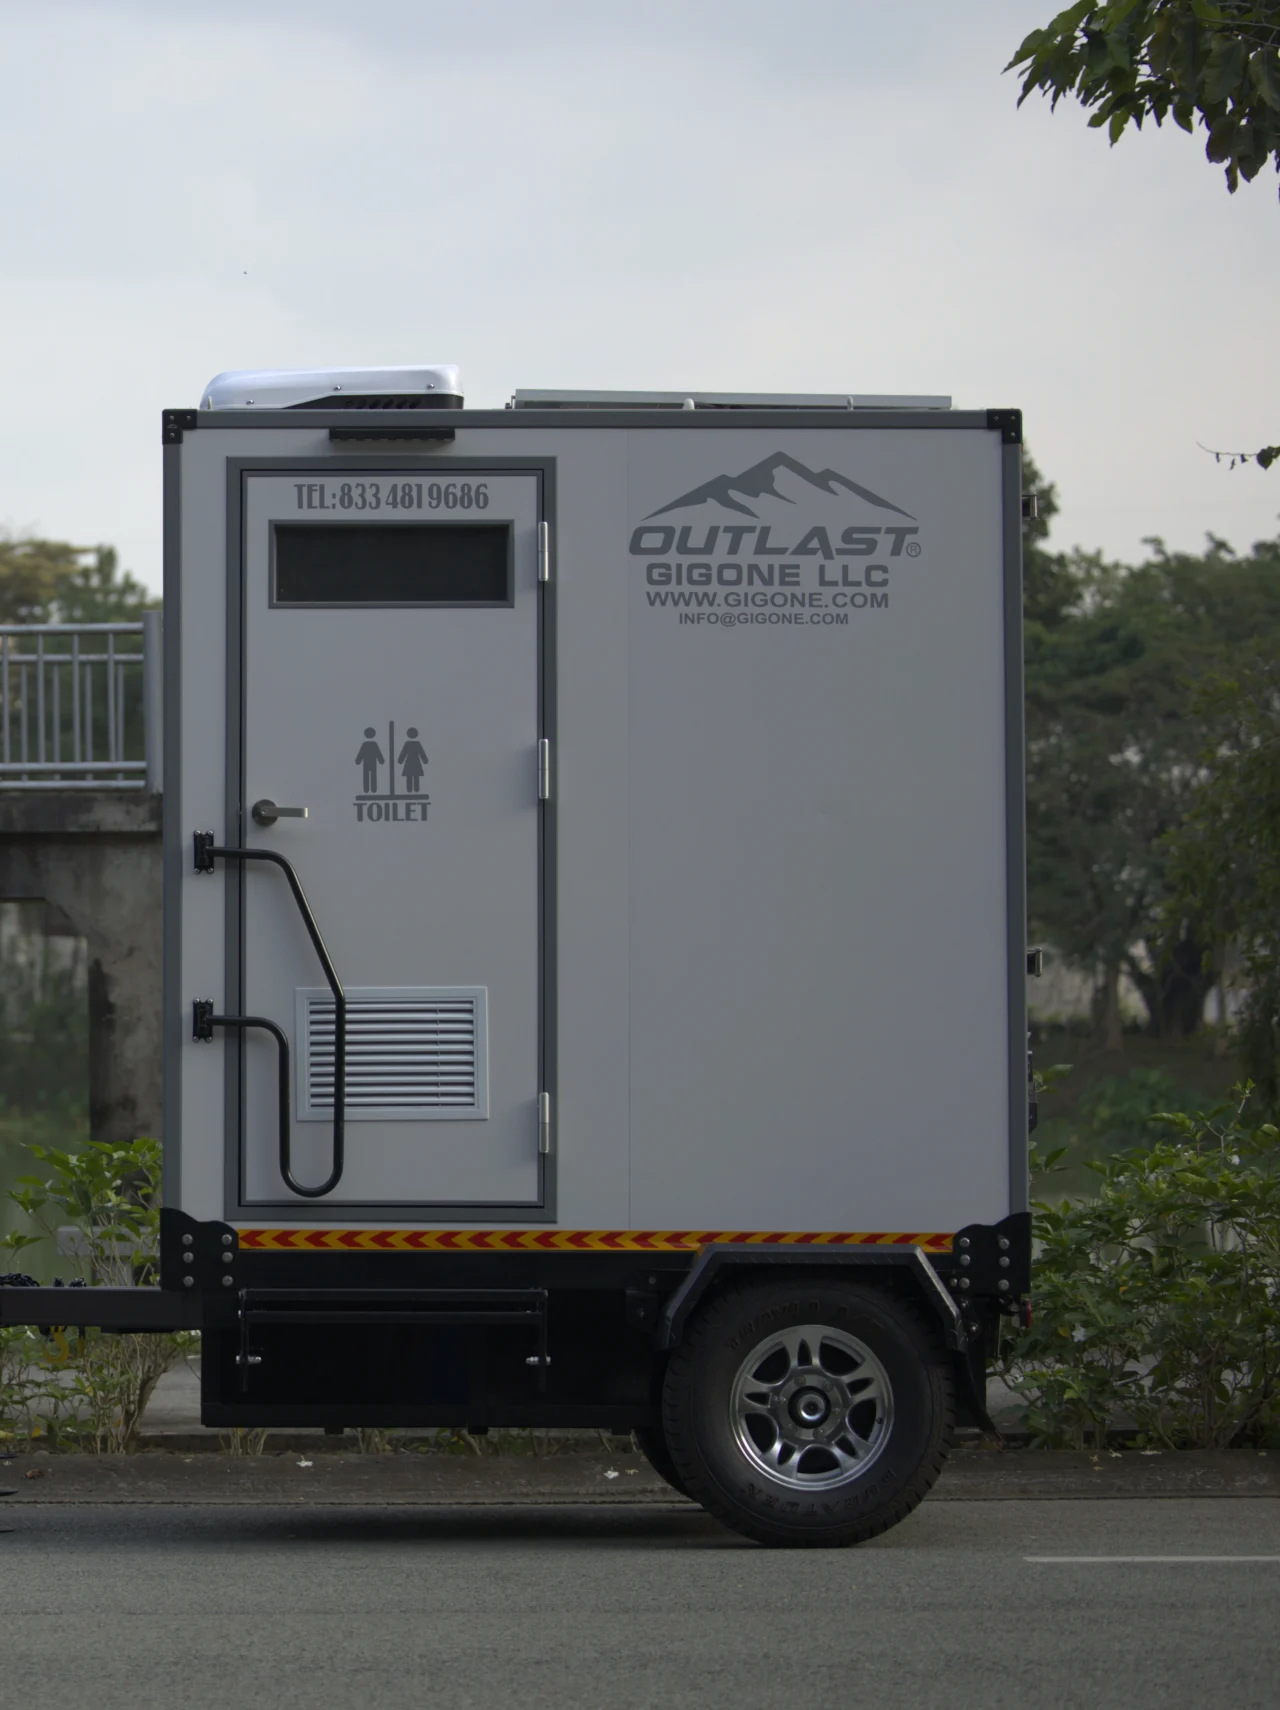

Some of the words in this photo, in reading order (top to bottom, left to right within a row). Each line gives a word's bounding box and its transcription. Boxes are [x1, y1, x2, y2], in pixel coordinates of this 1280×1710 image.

[385, 483, 423, 510] 481
[427, 483, 489, 510] 9686
[646, 562, 801, 587] GIGONE
[818, 563, 889, 588] LLC
[645, 591, 889, 609] WWW.GIGONE.COM
[678, 612, 849, 627] INFO@GIGONE.COM
[352, 801, 432, 822] TOILET
